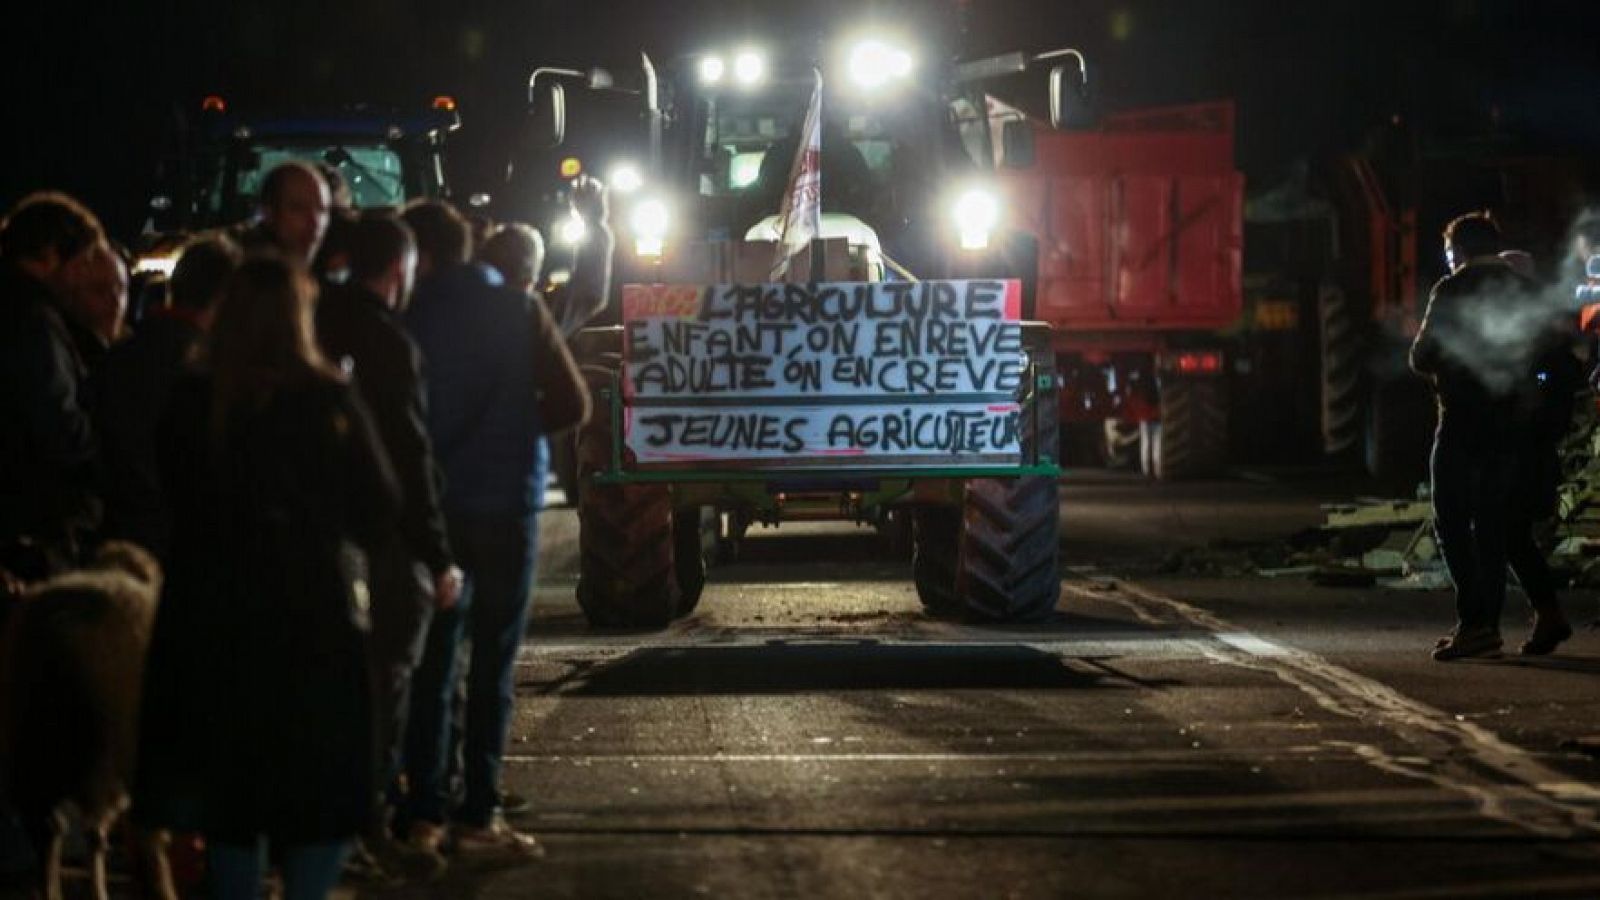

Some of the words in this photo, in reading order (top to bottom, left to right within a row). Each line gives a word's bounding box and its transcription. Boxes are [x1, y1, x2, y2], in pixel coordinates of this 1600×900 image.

[634, 354, 776, 393] ADULTE
[877, 358, 1020, 394] CREVE
[639, 413, 808, 454] JEUNES
